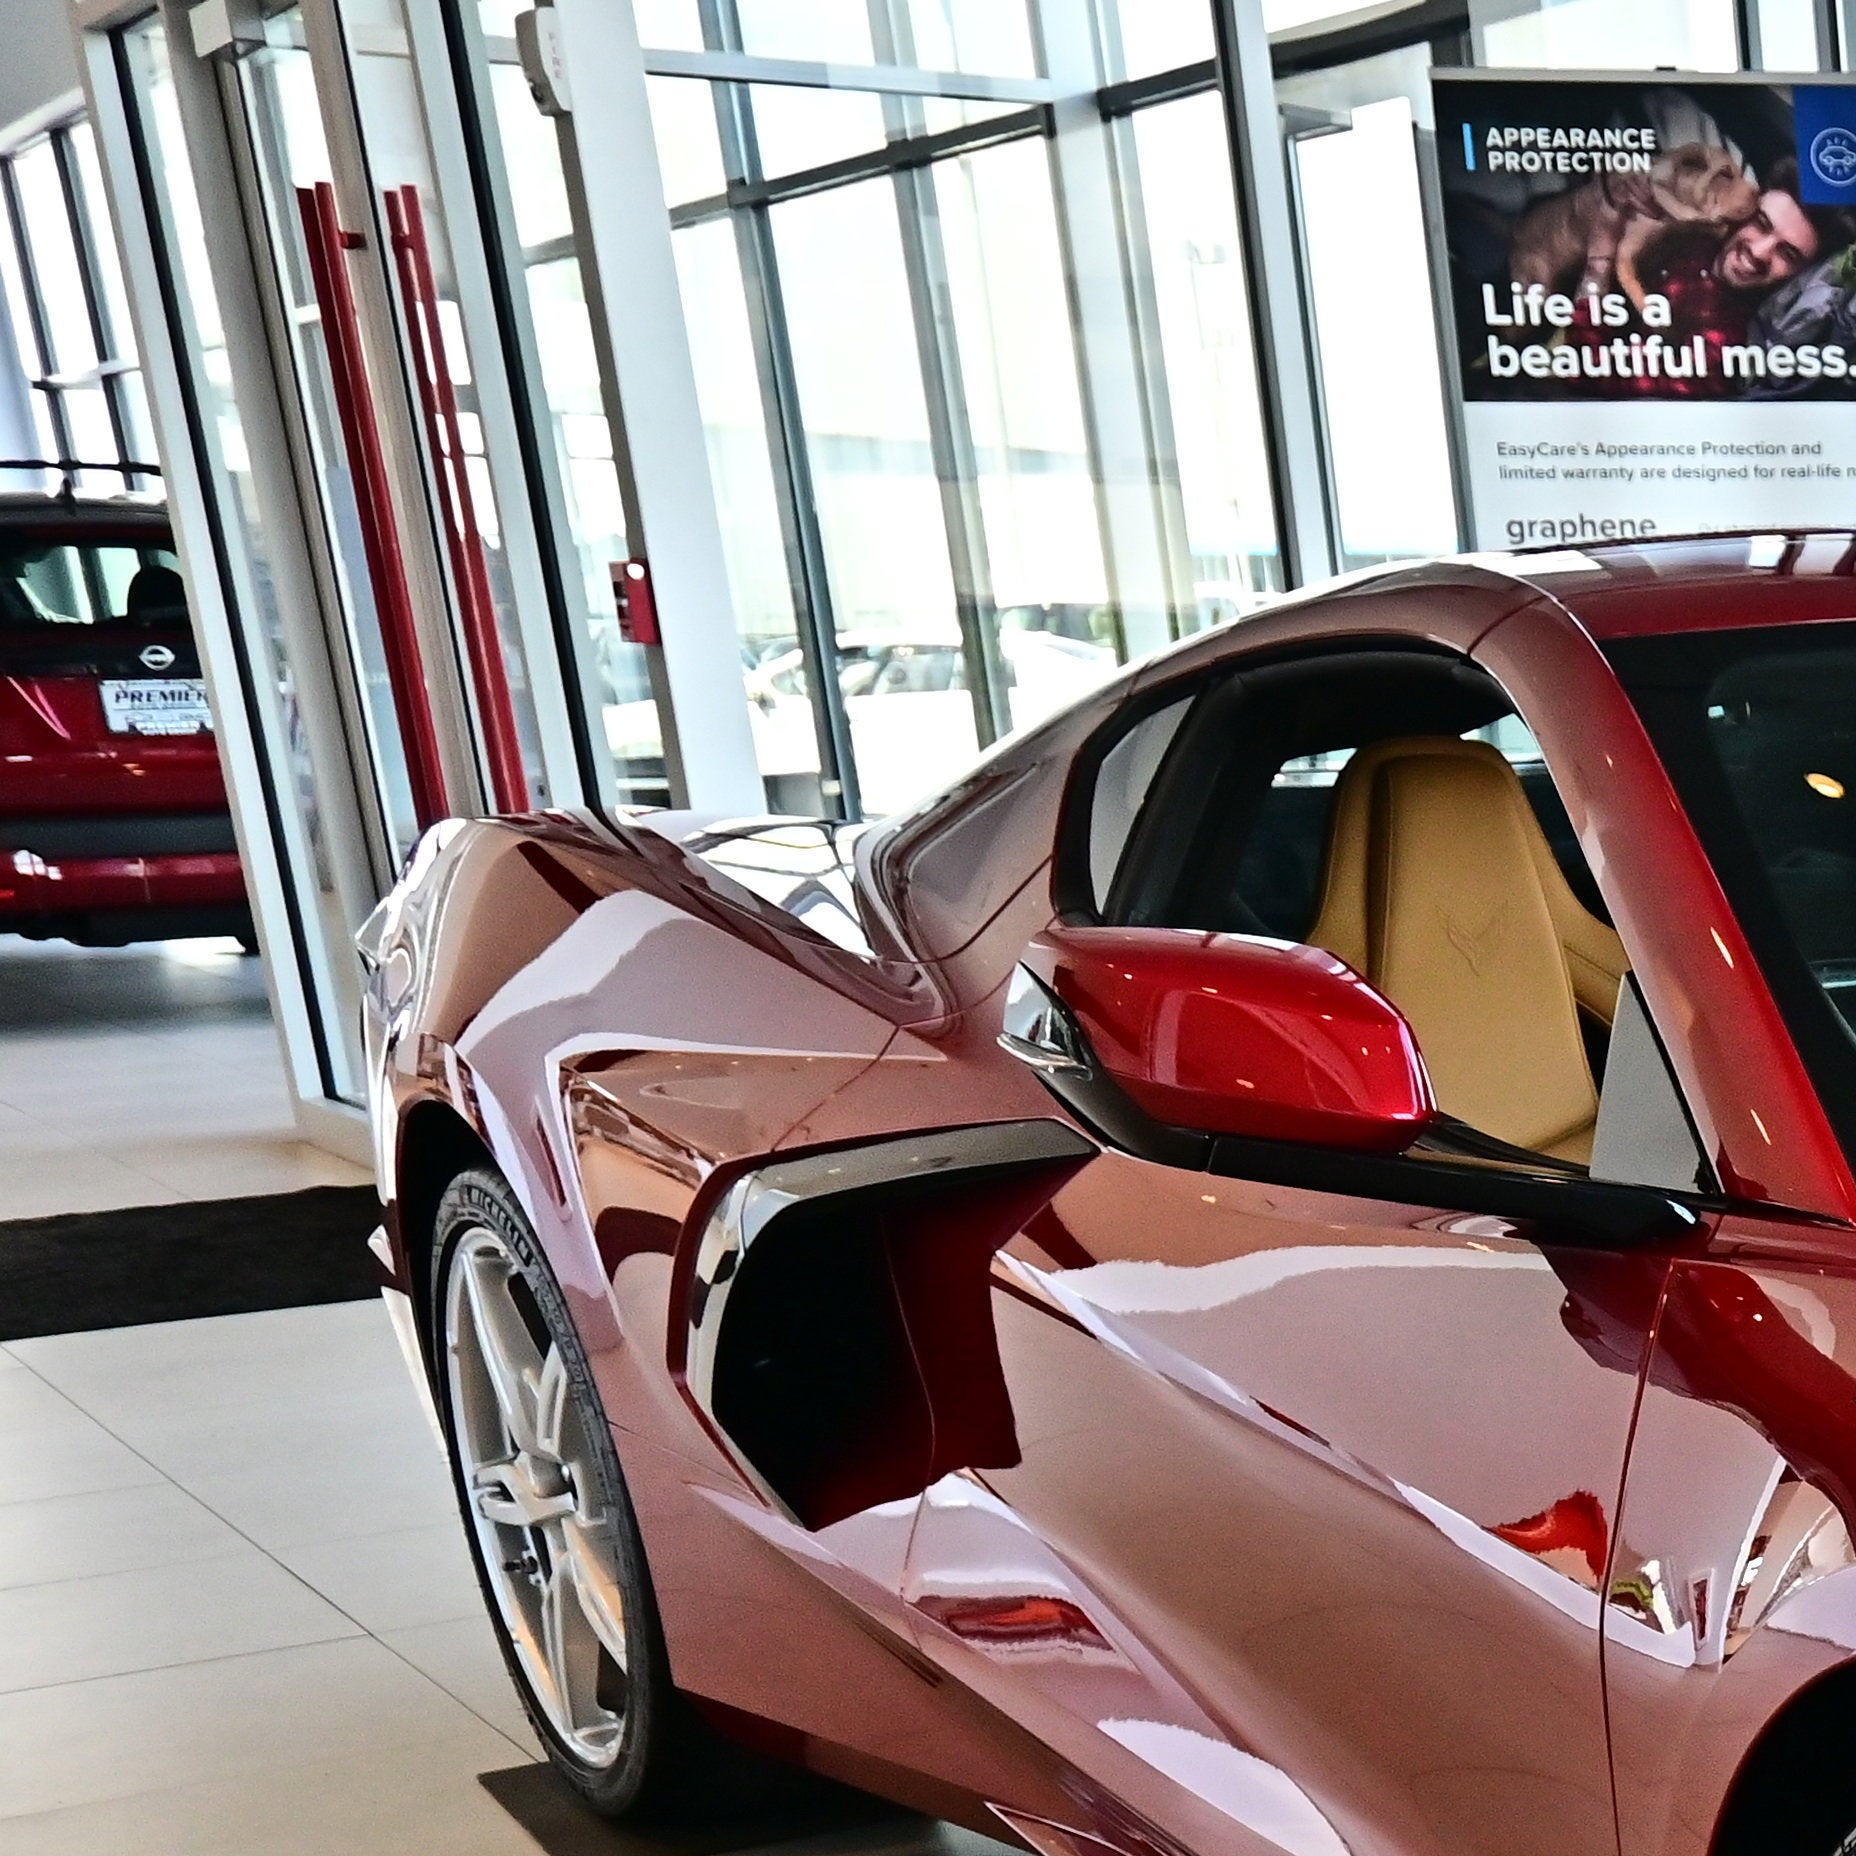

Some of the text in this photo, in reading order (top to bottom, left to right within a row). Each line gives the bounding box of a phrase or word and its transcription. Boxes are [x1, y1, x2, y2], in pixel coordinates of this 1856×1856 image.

[1485, 127, 1656, 150] APPEARANCE
[1488, 151, 1652, 173] PROTECTION
[1482, 283, 1671, 327] Life is a
[1487, 334, 1706, 377] beautiful
[1497, 440, 1822, 459] EasyCare's Appearance Protection and
[1499, 464, 1556, 480] limited
[1561, 466, 1634, 482] warranty
[1640, 467, 1666, 480] are
[1672, 463, 1748, 481] designed
[1753, 463, 1776, 479] for
[1780, 463, 1841, 479] real-life
[1506, 514, 1656, 544] graphene
